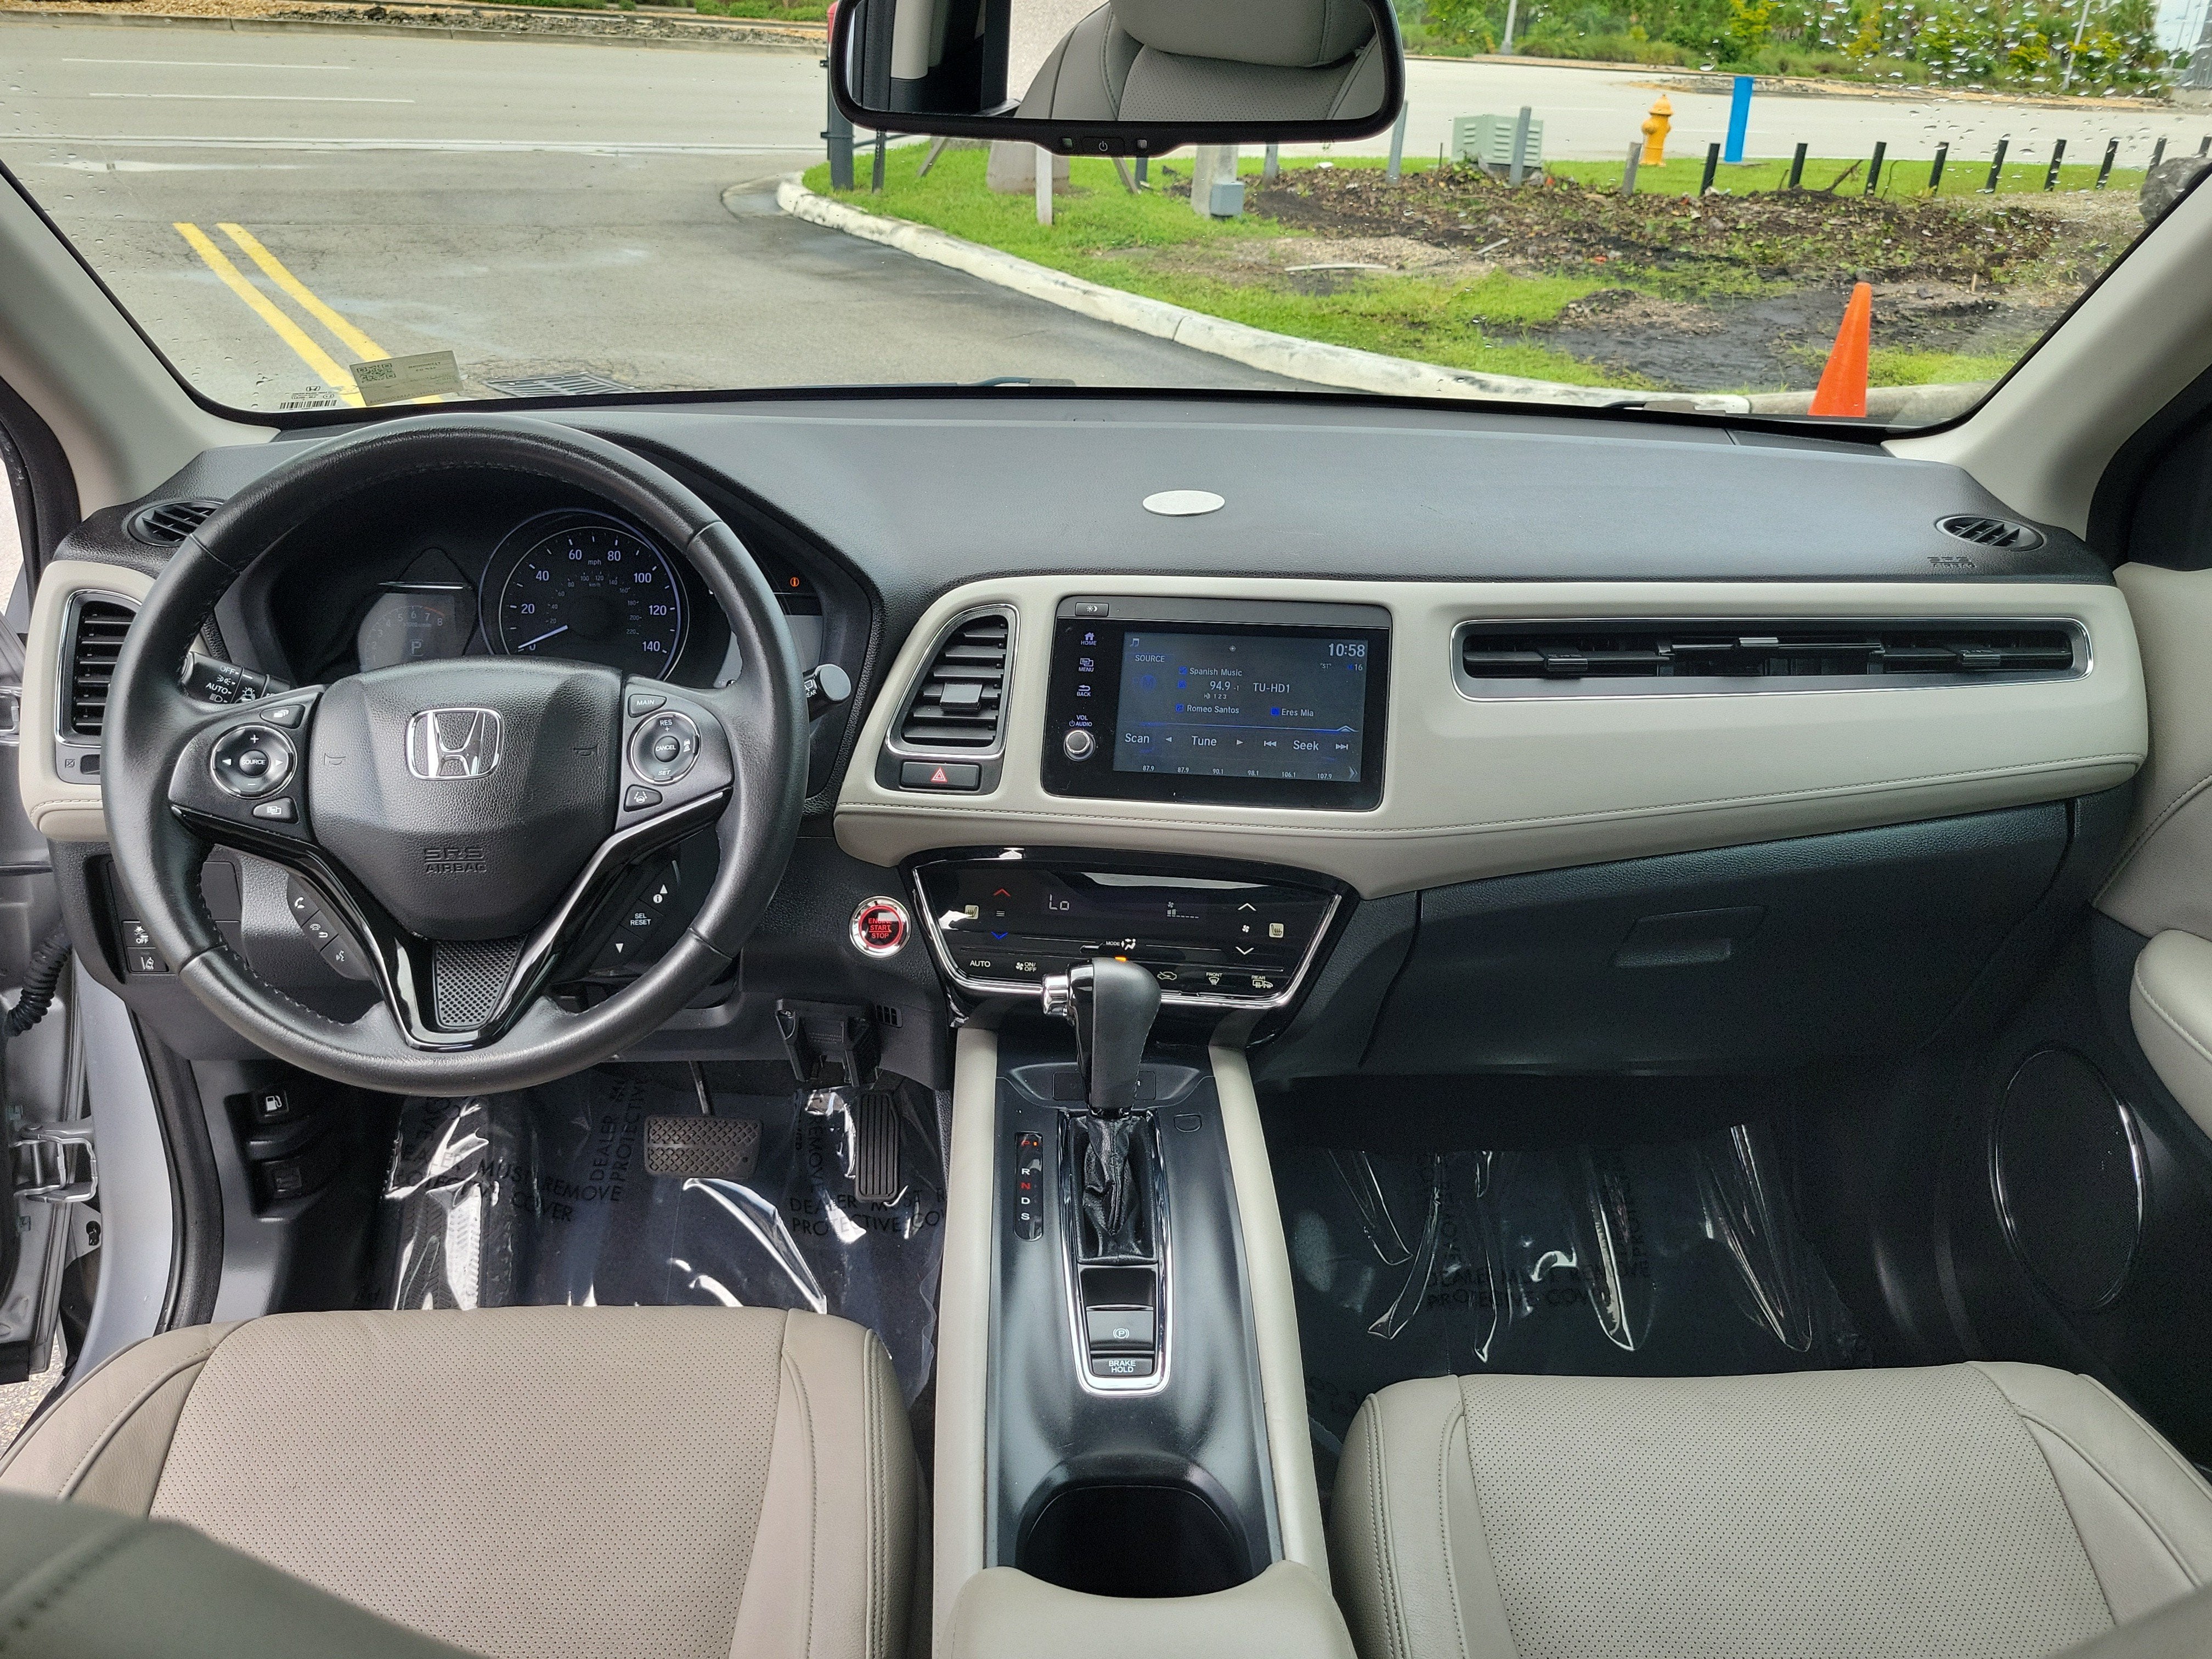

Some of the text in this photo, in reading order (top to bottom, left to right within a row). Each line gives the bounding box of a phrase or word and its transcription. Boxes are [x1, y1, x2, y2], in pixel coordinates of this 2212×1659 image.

[568, 550, 582, 560] 60
[607, 551, 621, 561] 80
[535, 571, 549, 581] 40
[634, 573, 651, 583] 100
[521, 604, 535, 614] 20
[648, 605, 667, 616] 120
[412, 641, 422, 654] P
[642, 641, 660, 652] 140
[1329, 643, 1365, 657] 10:58
[1135, 654, 1165, 663] SOURCE
[220, 665, 235, 674] OFF
[1189, 668, 1243, 676] Spanish Music
[206, 682, 228, 695] AUTO
[1210, 681, 1231, 691] 94.9
[1253, 683, 1290, 693] TU-HD1
[806, 690, 817, 698] EAR
[1125, 733, 1150, 744] Scan
[1192, 736, 1217, 747] Tune
[1293, 741, 1319, 751] Seek
[425, 848, 484, 860] SRS
[425, 863, 487, 873] AIRBAG
[1049, 894, 1070, 911] Lo
[589, 1115, 619, 1181] DEALER
[790, 1194, 857, 1214] DEAER
